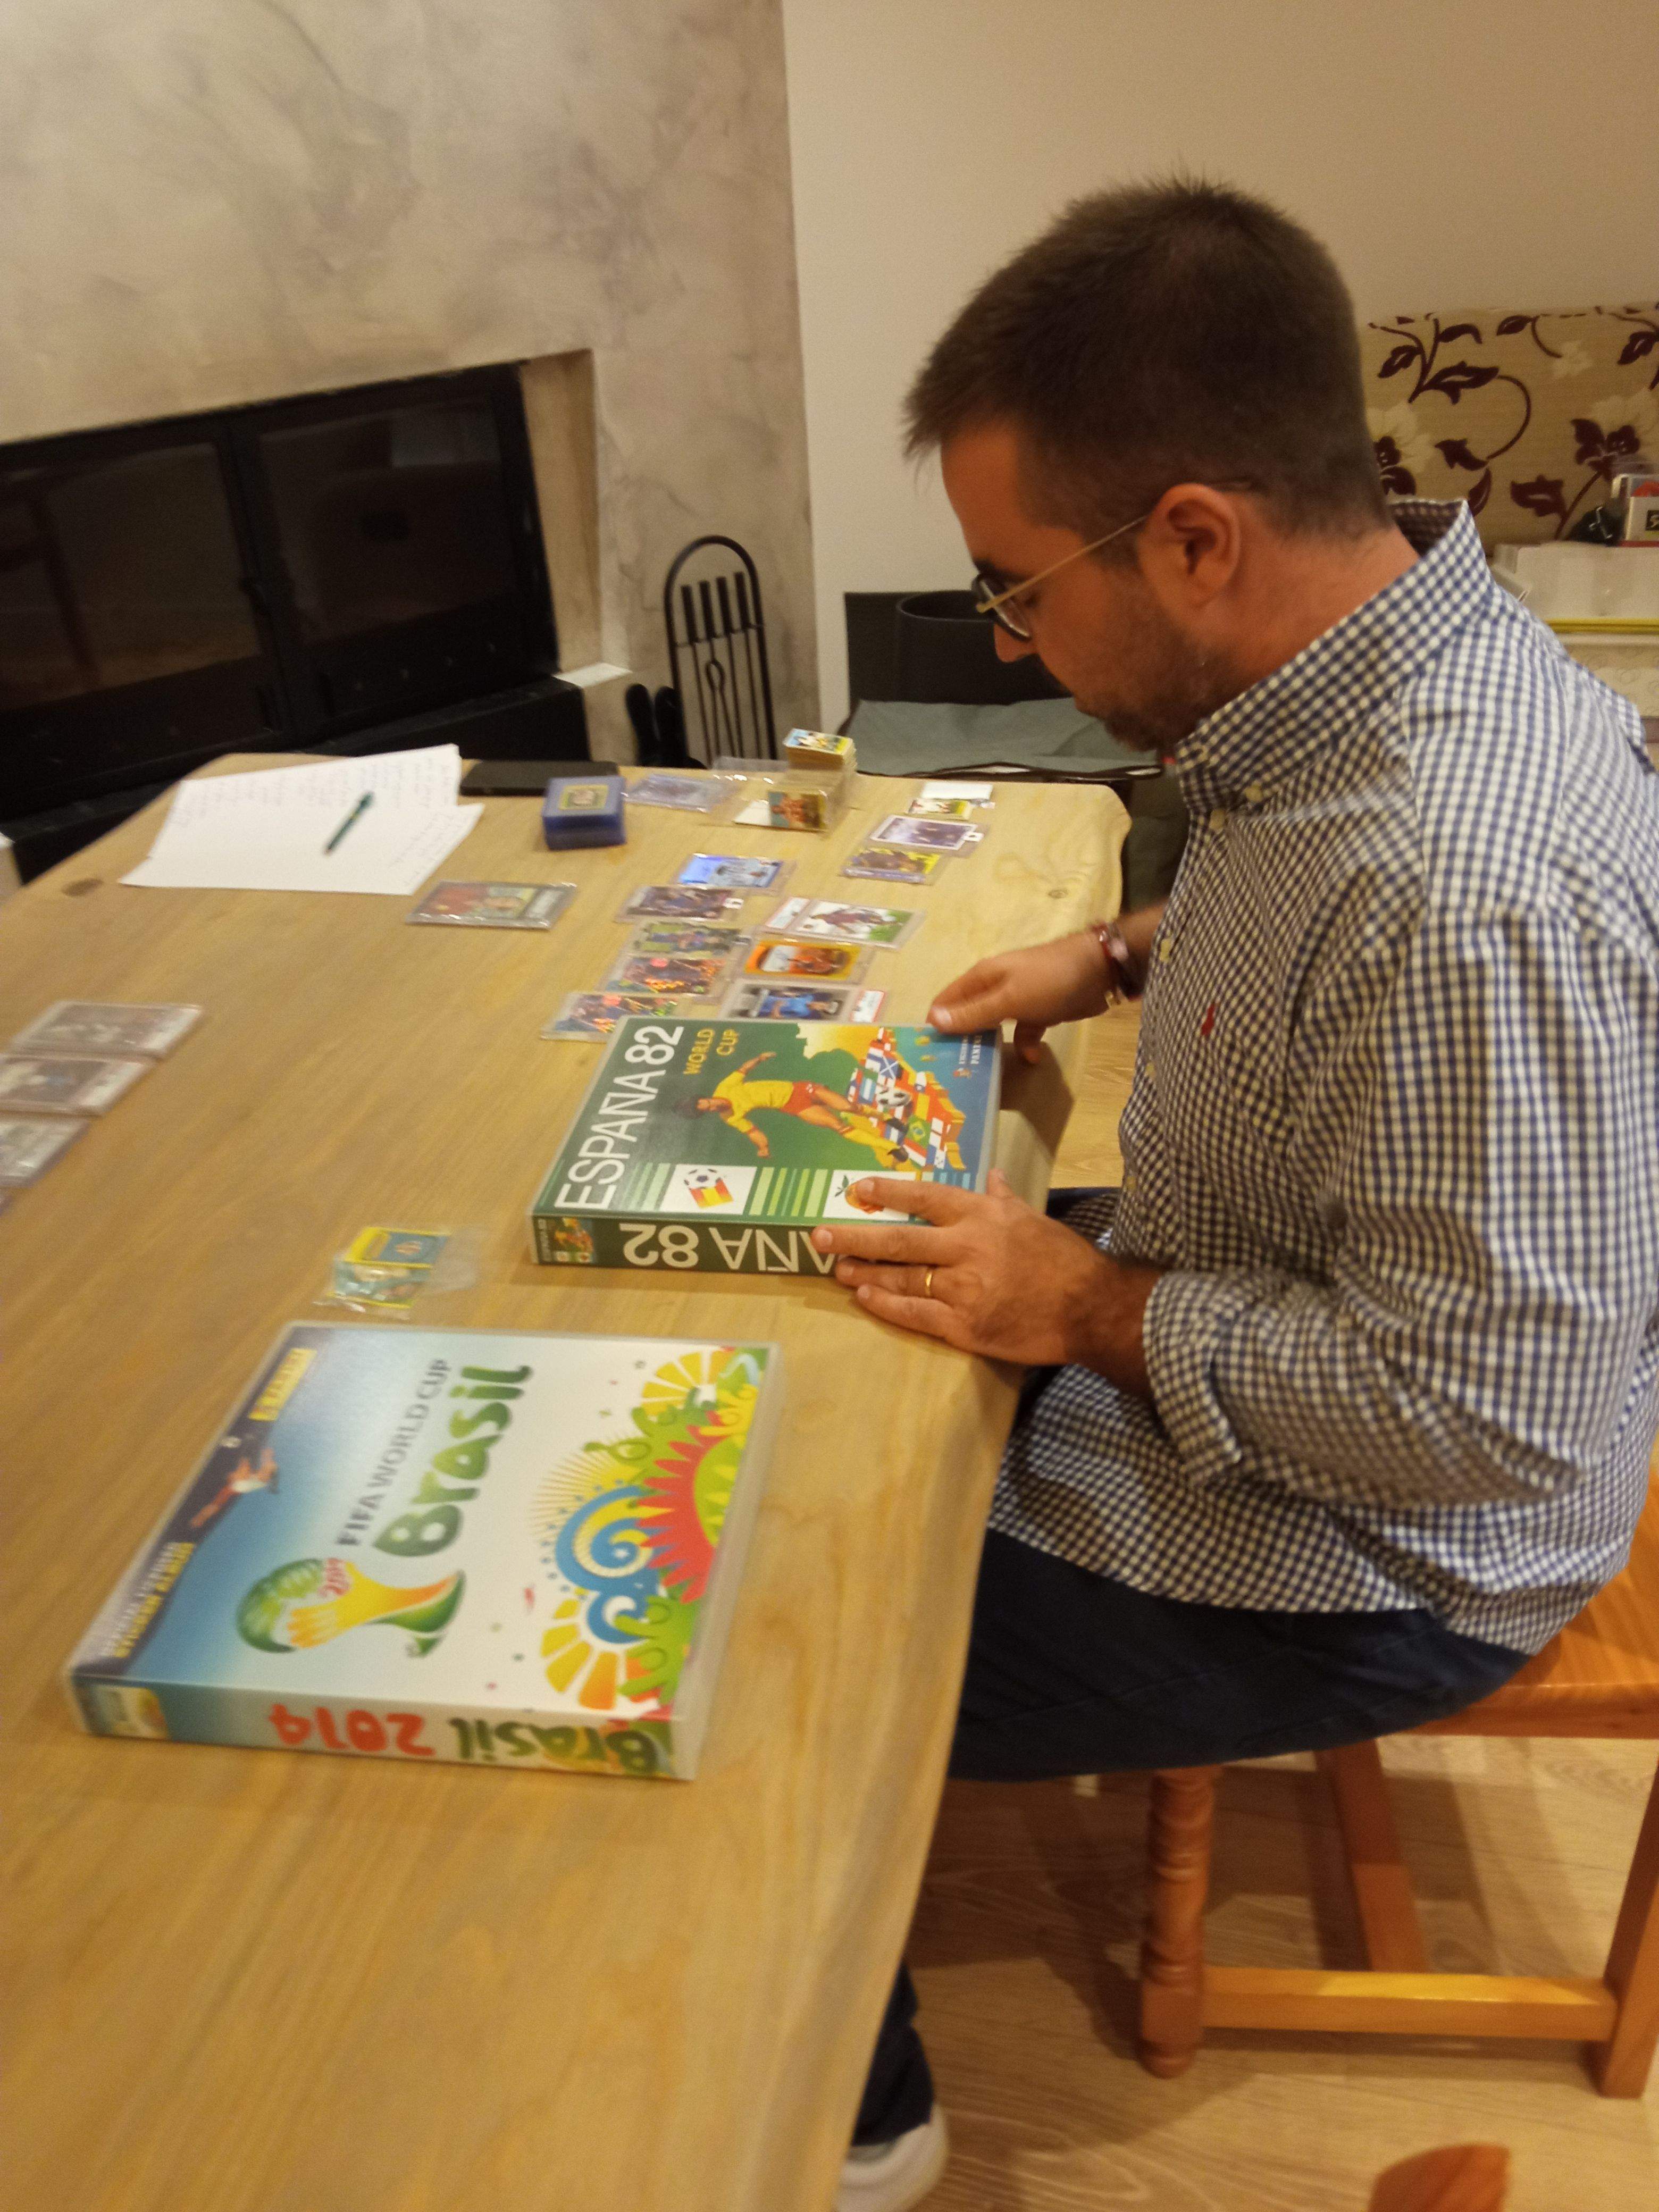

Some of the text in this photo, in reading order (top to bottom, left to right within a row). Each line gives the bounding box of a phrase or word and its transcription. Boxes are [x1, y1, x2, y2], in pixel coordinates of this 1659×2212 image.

[683, 1028, 715, 1075] WORLD
[716, 1028, 739, 1057] CUP
[555, 1025, 684, 1210] ESPAÑA 82
[618, 1222, 699, 1268] 82
[337, 1358, 451, 1546] FIFA WORLD CUP
[269, 1703, 435, 1757] 2014
